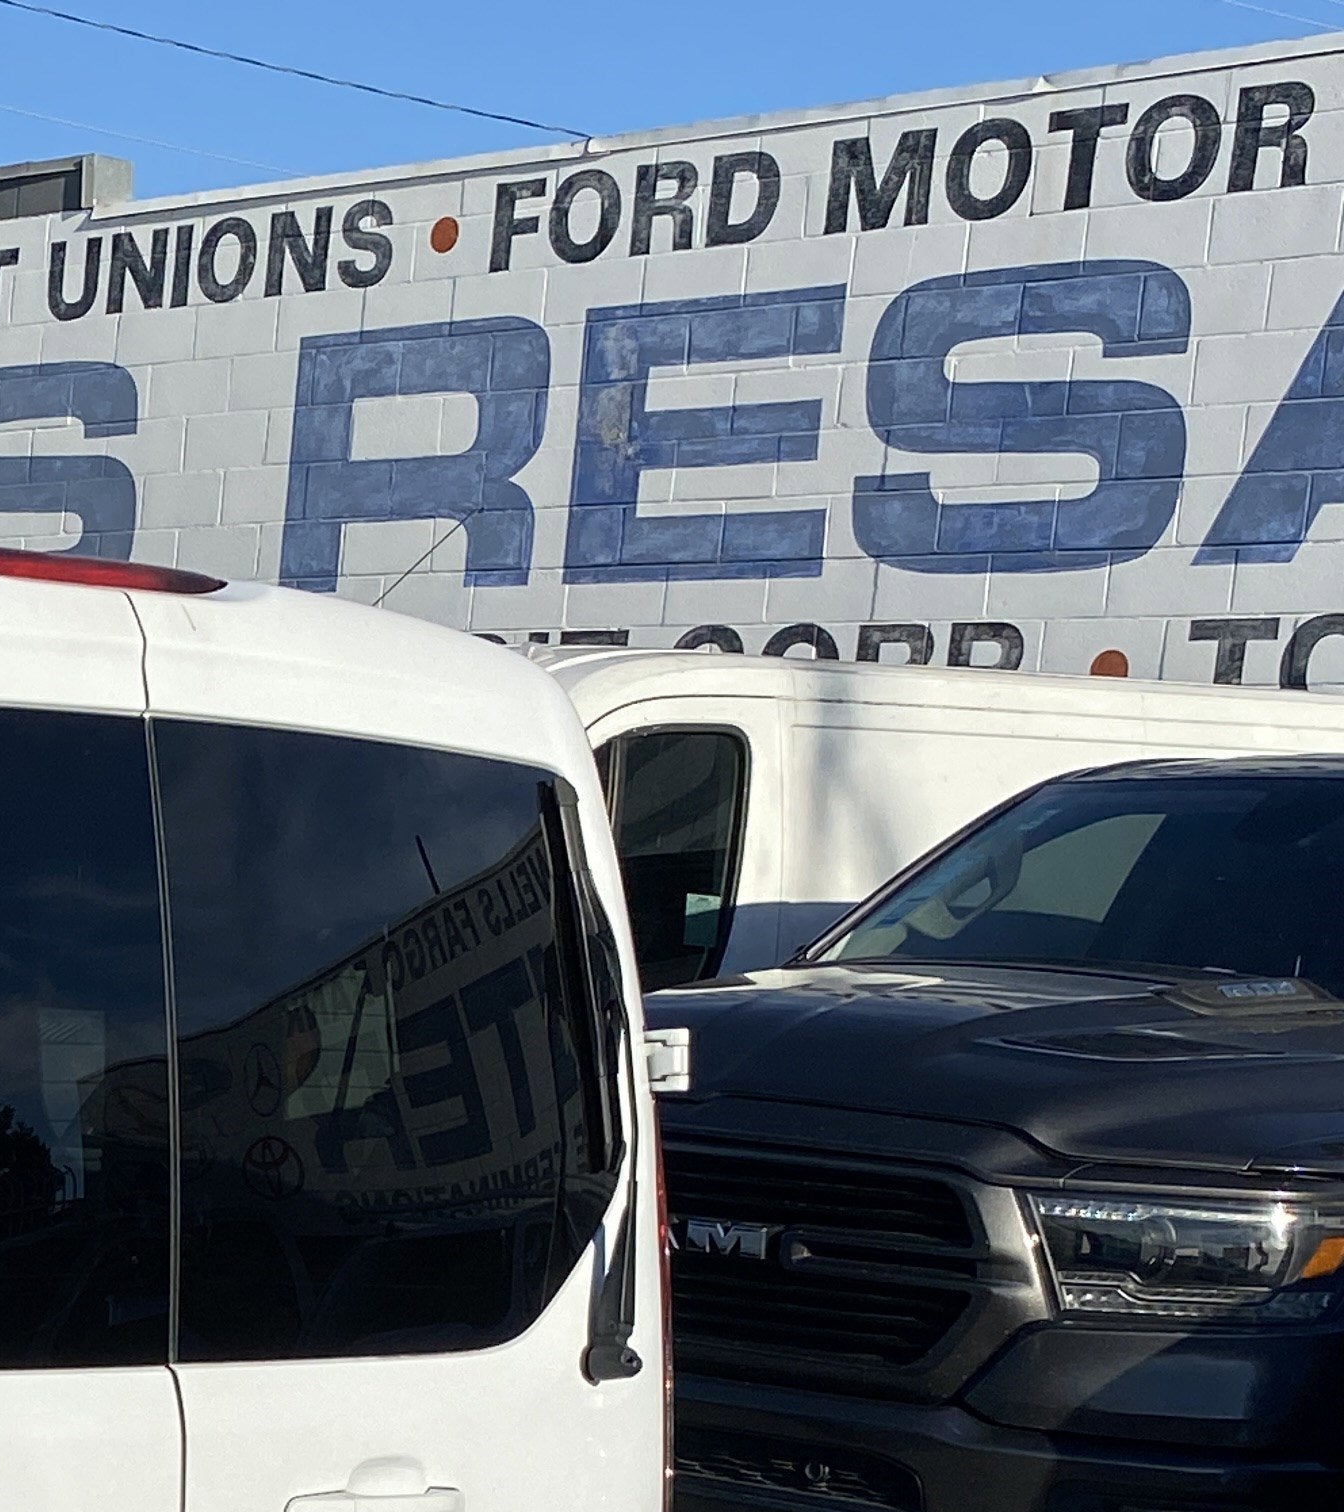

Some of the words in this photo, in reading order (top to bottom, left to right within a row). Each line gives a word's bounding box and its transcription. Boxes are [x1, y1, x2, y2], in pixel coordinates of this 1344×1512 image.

[47, 199, 393, 321] UNIONS
[489, 149, 781, 272] FORD
[824, 80, 1315, 235] MOTOR
